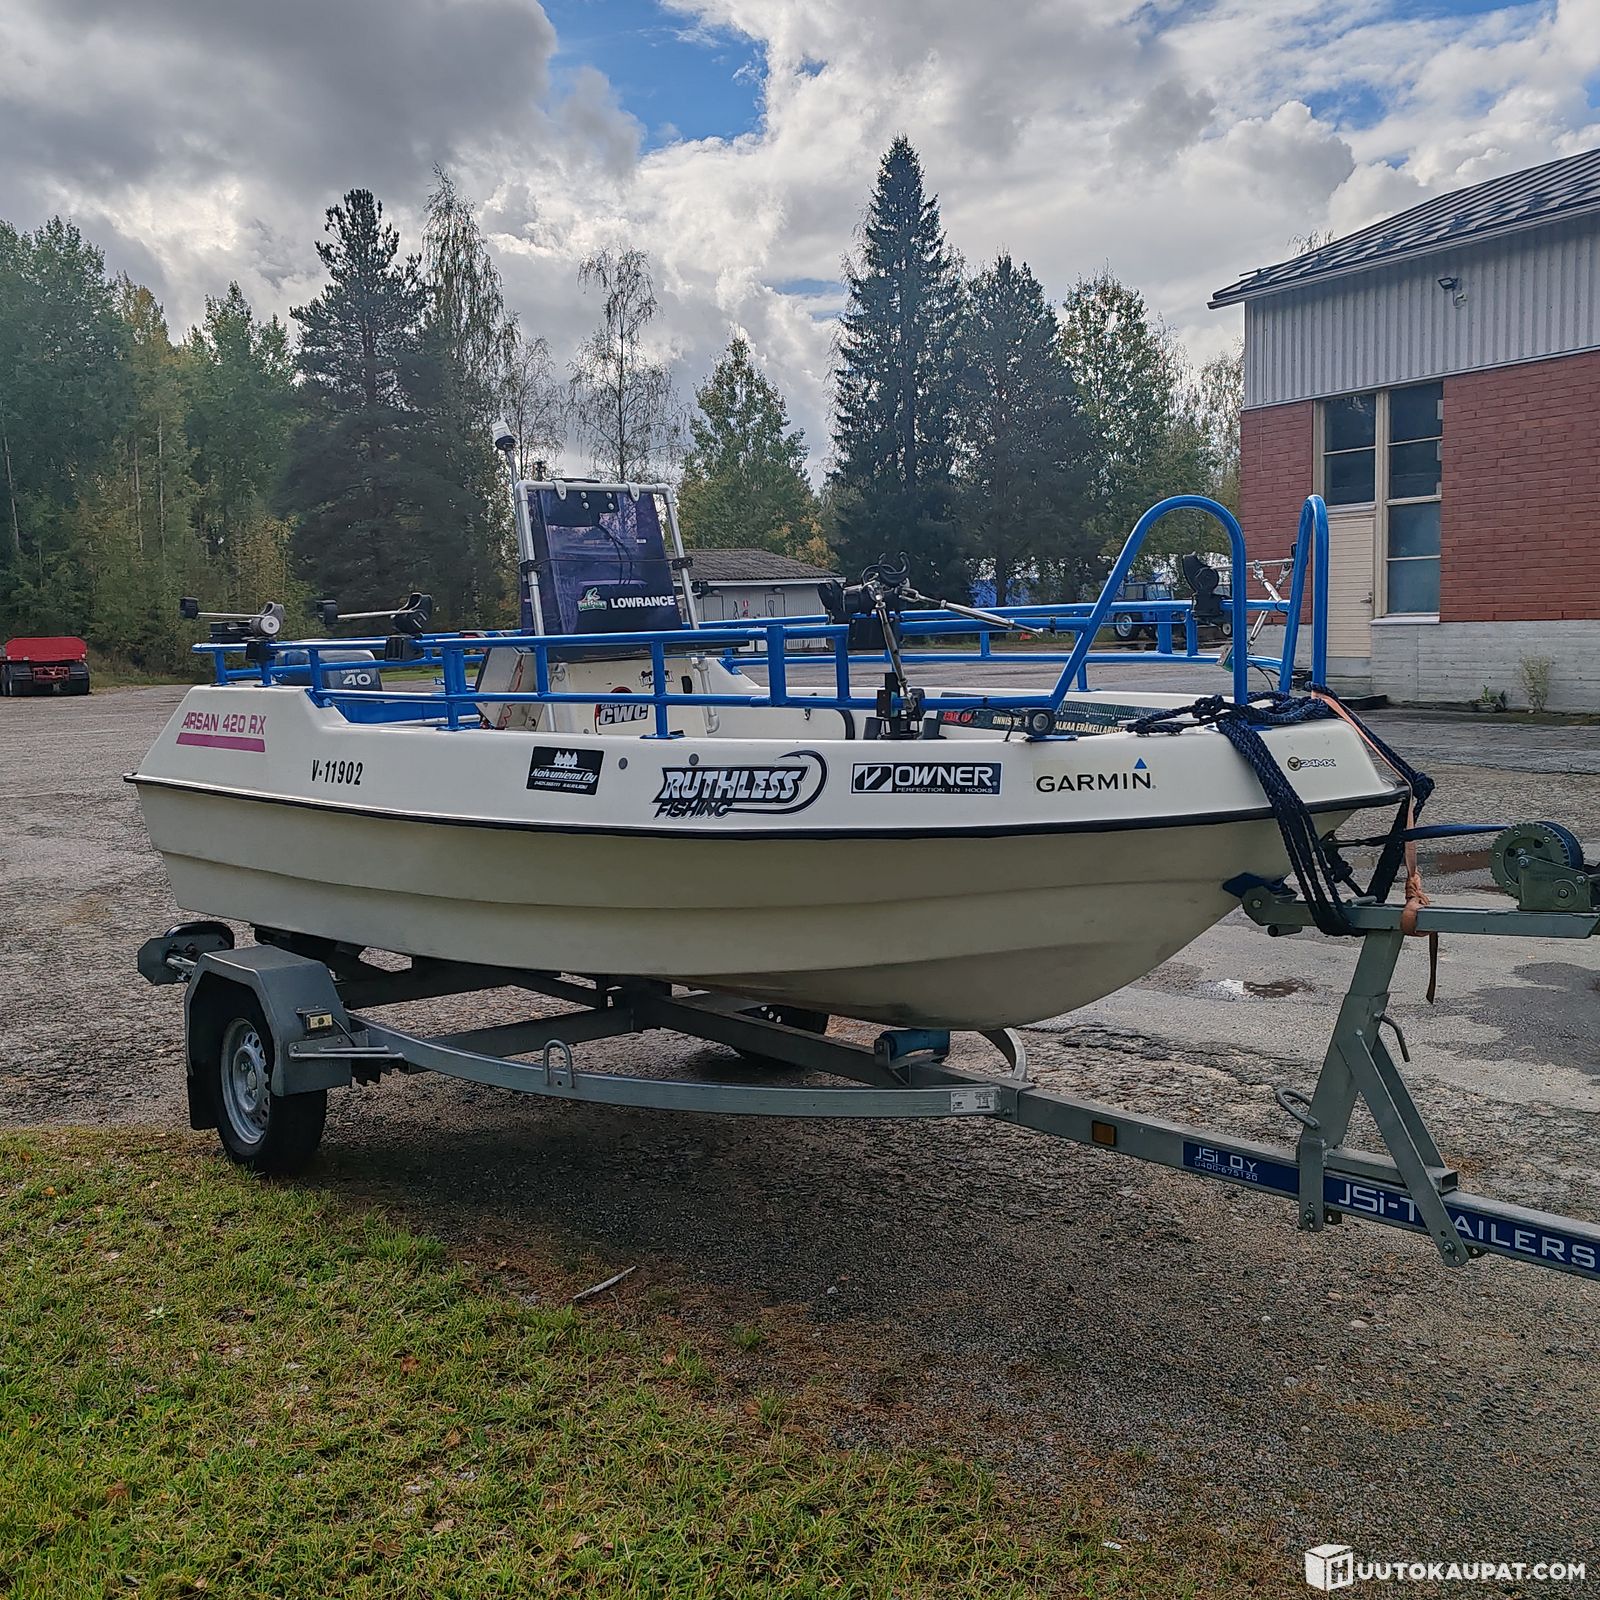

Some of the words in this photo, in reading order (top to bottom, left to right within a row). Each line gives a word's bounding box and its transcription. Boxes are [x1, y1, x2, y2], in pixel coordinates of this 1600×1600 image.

[610, 595, 676, 609] LOWRANCE
[342, 673, 371, 686] 40
[182, 711, 219, 733] ARSAN
[222, 713, 246, 734] 420
[248, 715, 267, 735] RX
[599, 704, 648, 725] CWC
[1055, 720, 1075, 731] ALKAA
[311, 759, 364, 786] V-11902
[894, 765, 994, 787] OWNER
[1035, 772, 1152, 793] GARMIN
[658, 770, 804, 800] RUTHLESS
[654, 800, 733, 818] FISHING
[1229, 1154, 1258, 1172] OY
